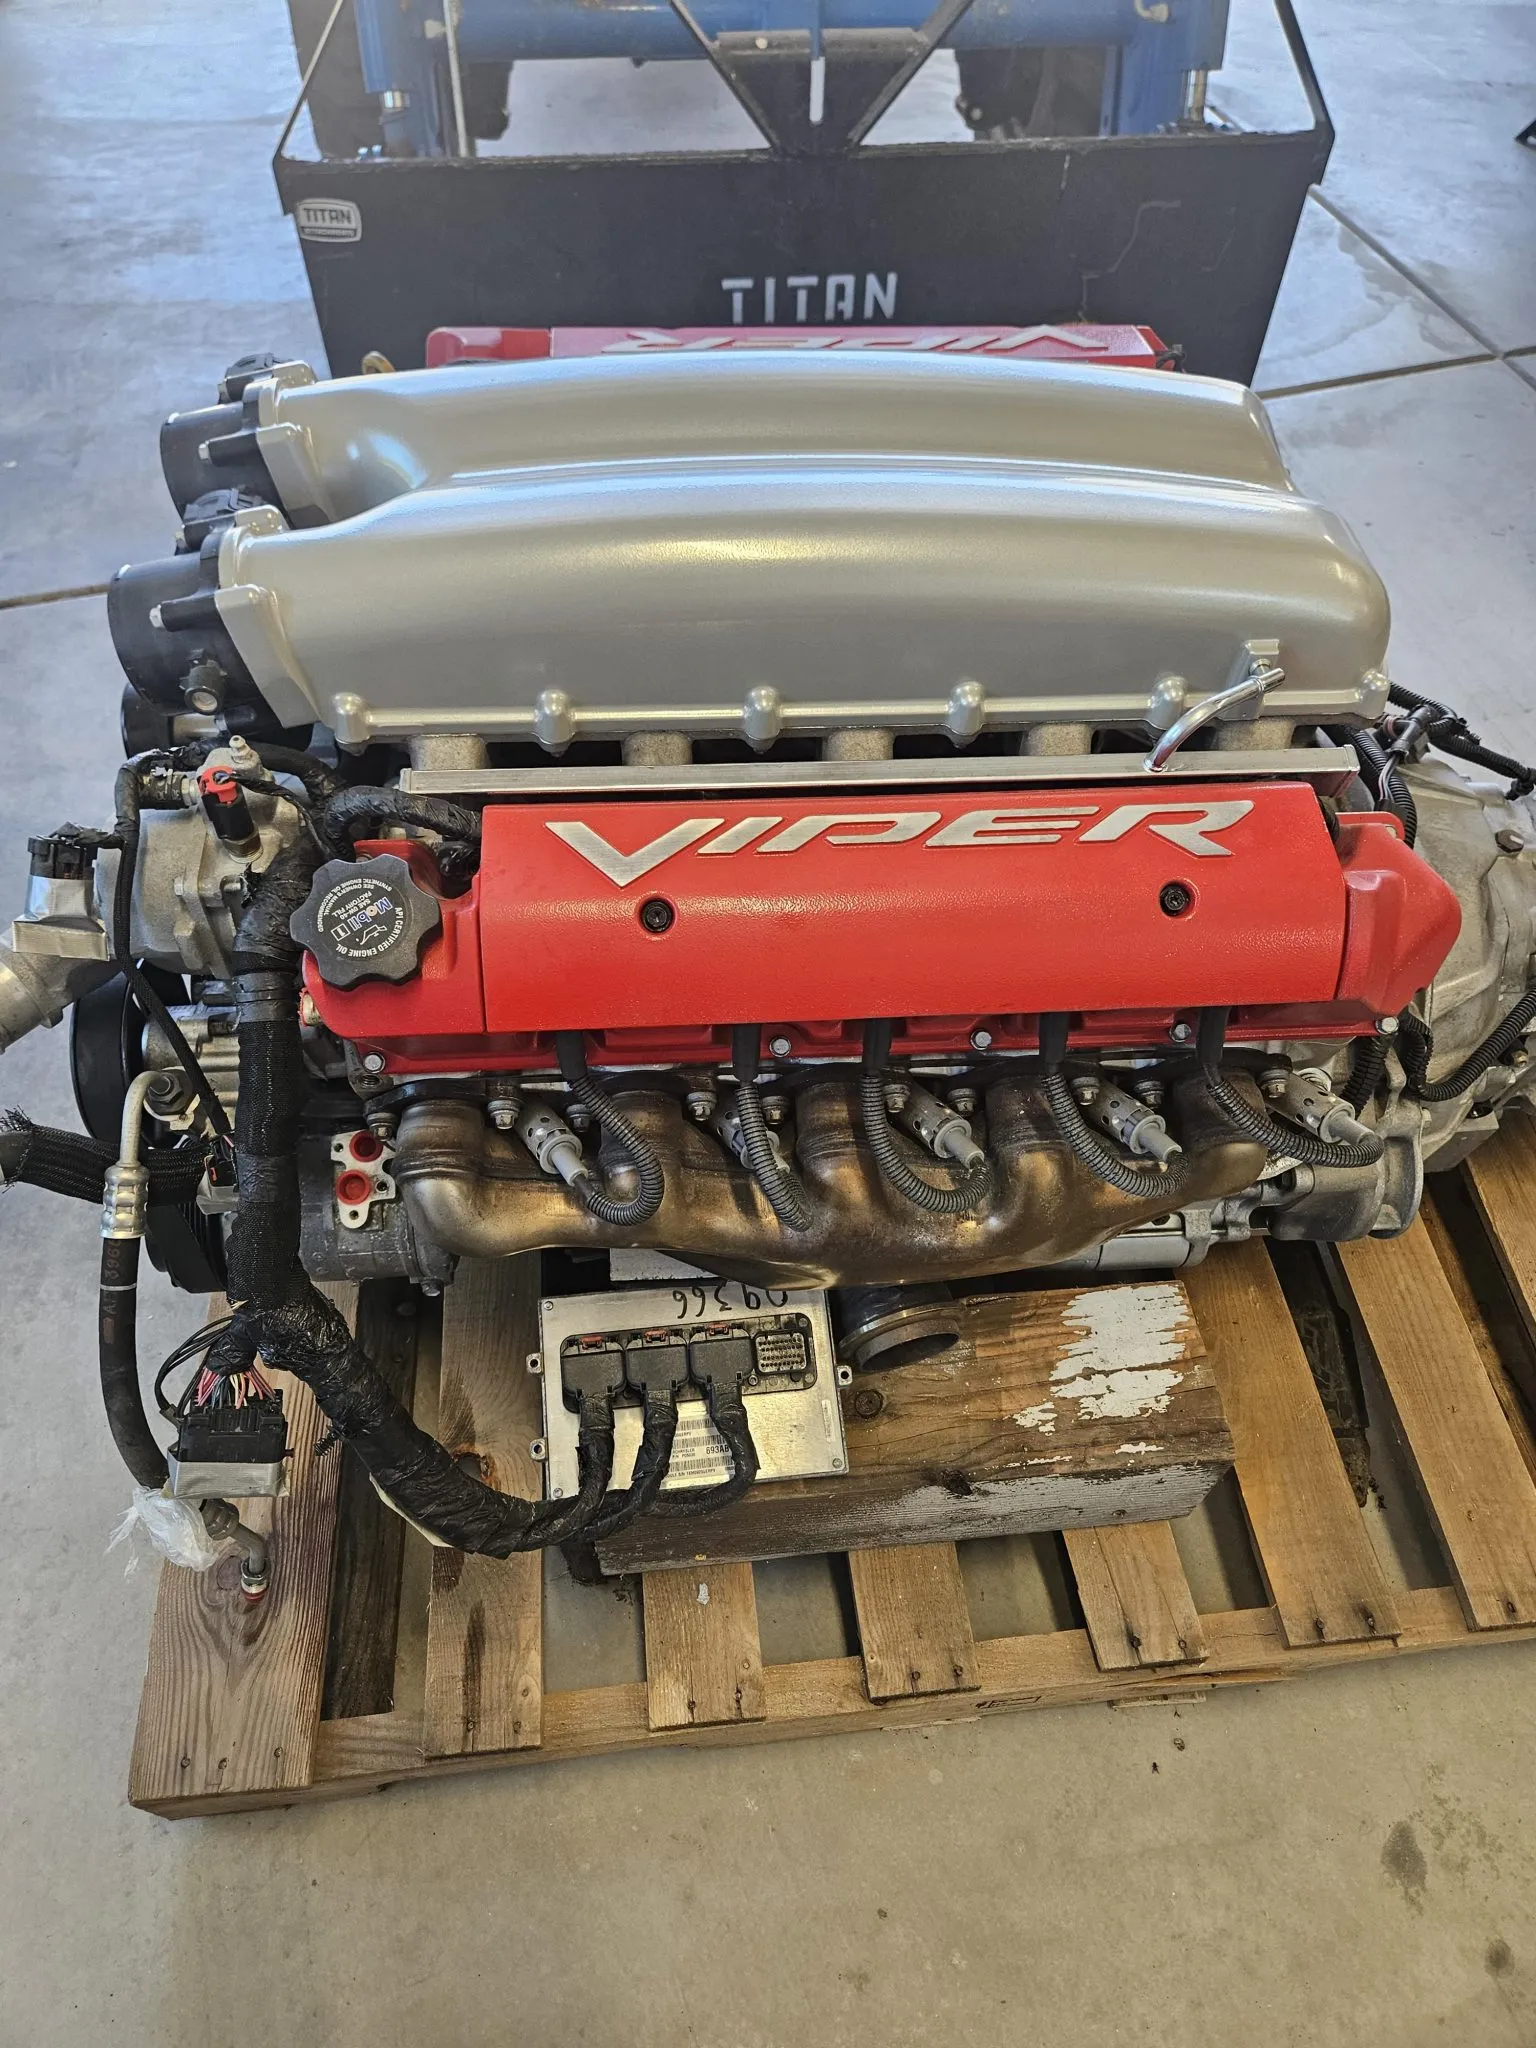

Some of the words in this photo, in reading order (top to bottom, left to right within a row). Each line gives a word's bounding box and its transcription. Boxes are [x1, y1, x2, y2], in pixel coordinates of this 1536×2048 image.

[303, 207, 352, 225] TITAN
[721, 272, 899, 325] TITAN
[544, 800, 1256, 889] VIPER
[337, 884, 362, 897] OWNER'S
[340, 879, 361, 888] ENGINE
[363, 879, 392, 891] SYNTHETIC
[324, 895, 338, 915] MANUAL
[346, 891, 372, 909] FACTORY
[358, 899, 371, 908] SAE
[317, 892, 333, 932] RECOMMENDED
[332, 908, 345, 917] FILL
[347, 897, 393, 931] Mobil
[395, 907, 403, 918] API
[378, 921, 403, 951] CERTIFIED
[336, 944, 347, 954] OIL
[348, 948, 377, 957] ENGINE
